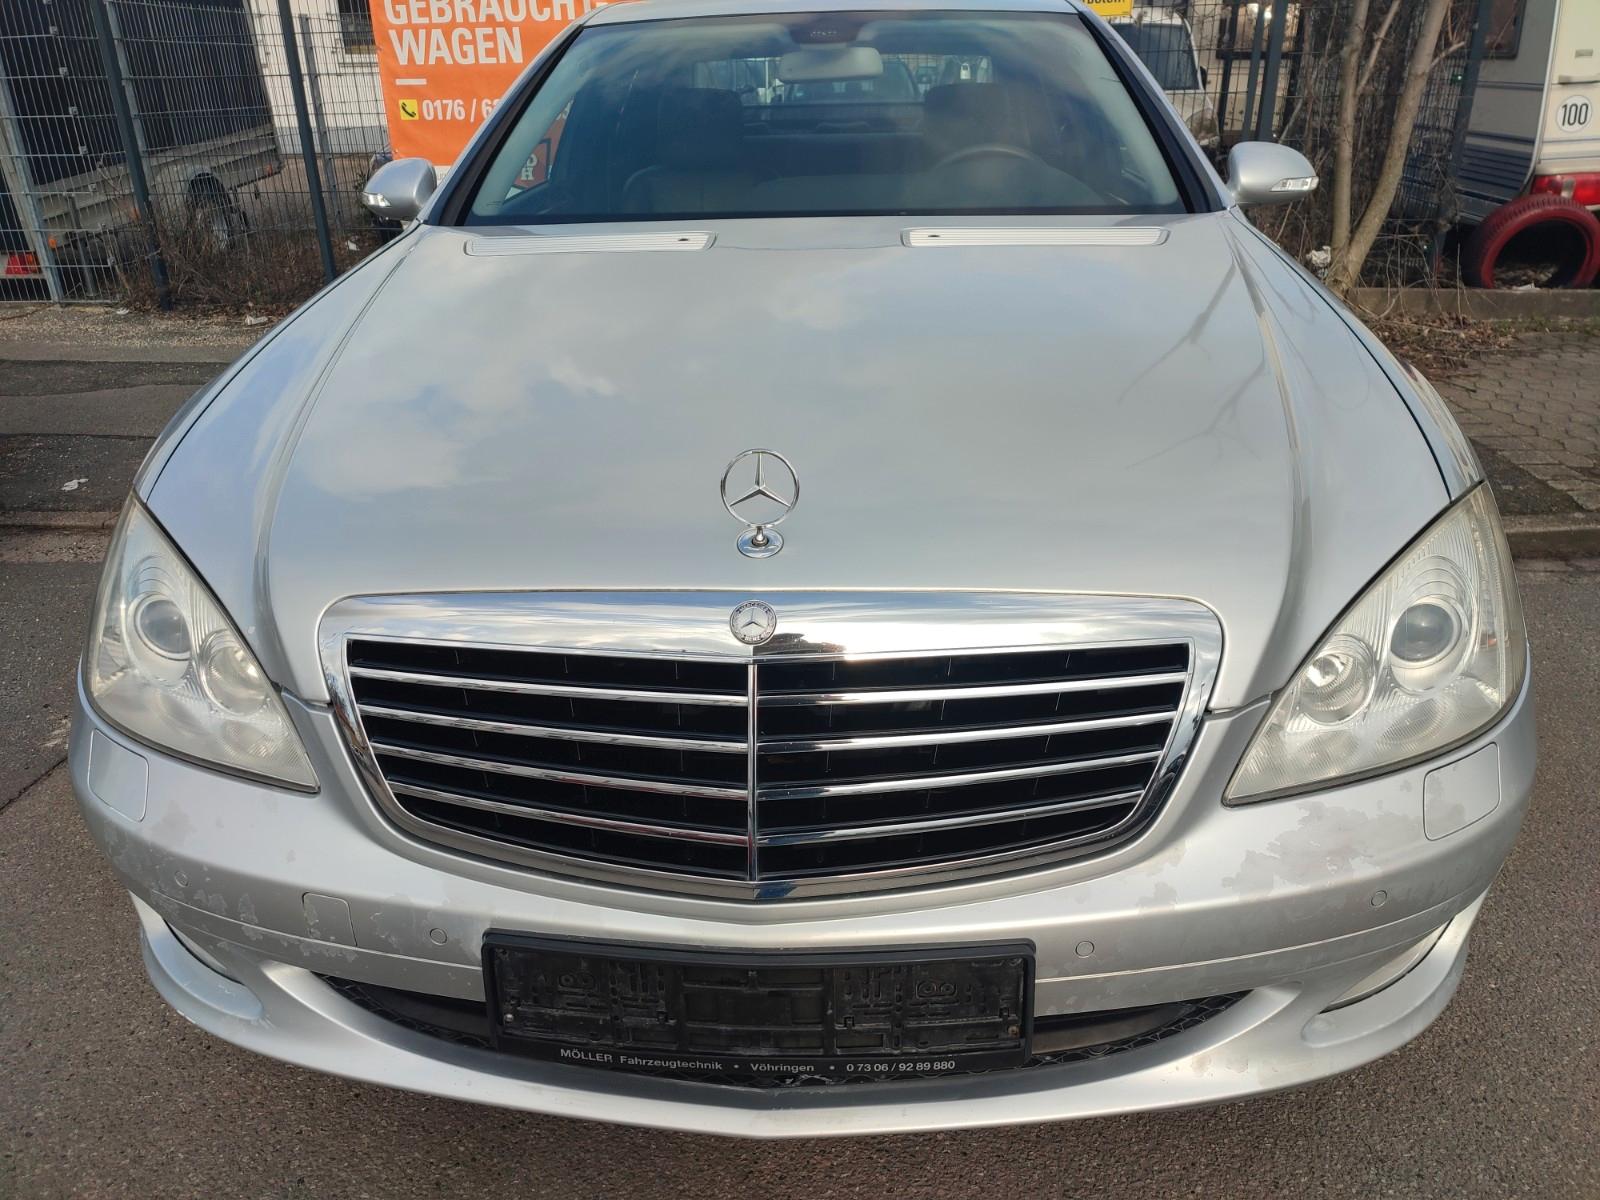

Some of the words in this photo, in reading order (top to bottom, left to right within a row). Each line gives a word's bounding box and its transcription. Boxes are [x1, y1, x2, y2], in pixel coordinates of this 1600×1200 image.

[388, 27, 523, 65] WAGEN
[422, 98, 466, 120] 0176
[469, 98, 477, 123] /
[1561, 102, 1589, 127] 100
[560, 1048, 613, 1063] MÖLLER
[620, 1055, 723, 1070] Fahrzeugtechnik
[750, 1062, 815, 1073] Vöhringen
[846, 1063, 855, 1072] 0
[857, 1063, 872, 1072] 73
[874, 1063, 889, 1072] 06
[899, 1062, 914, 1072] 92
[916, 1062, 931, 1071] 89
[933, 1060, 956, 1070] 880
